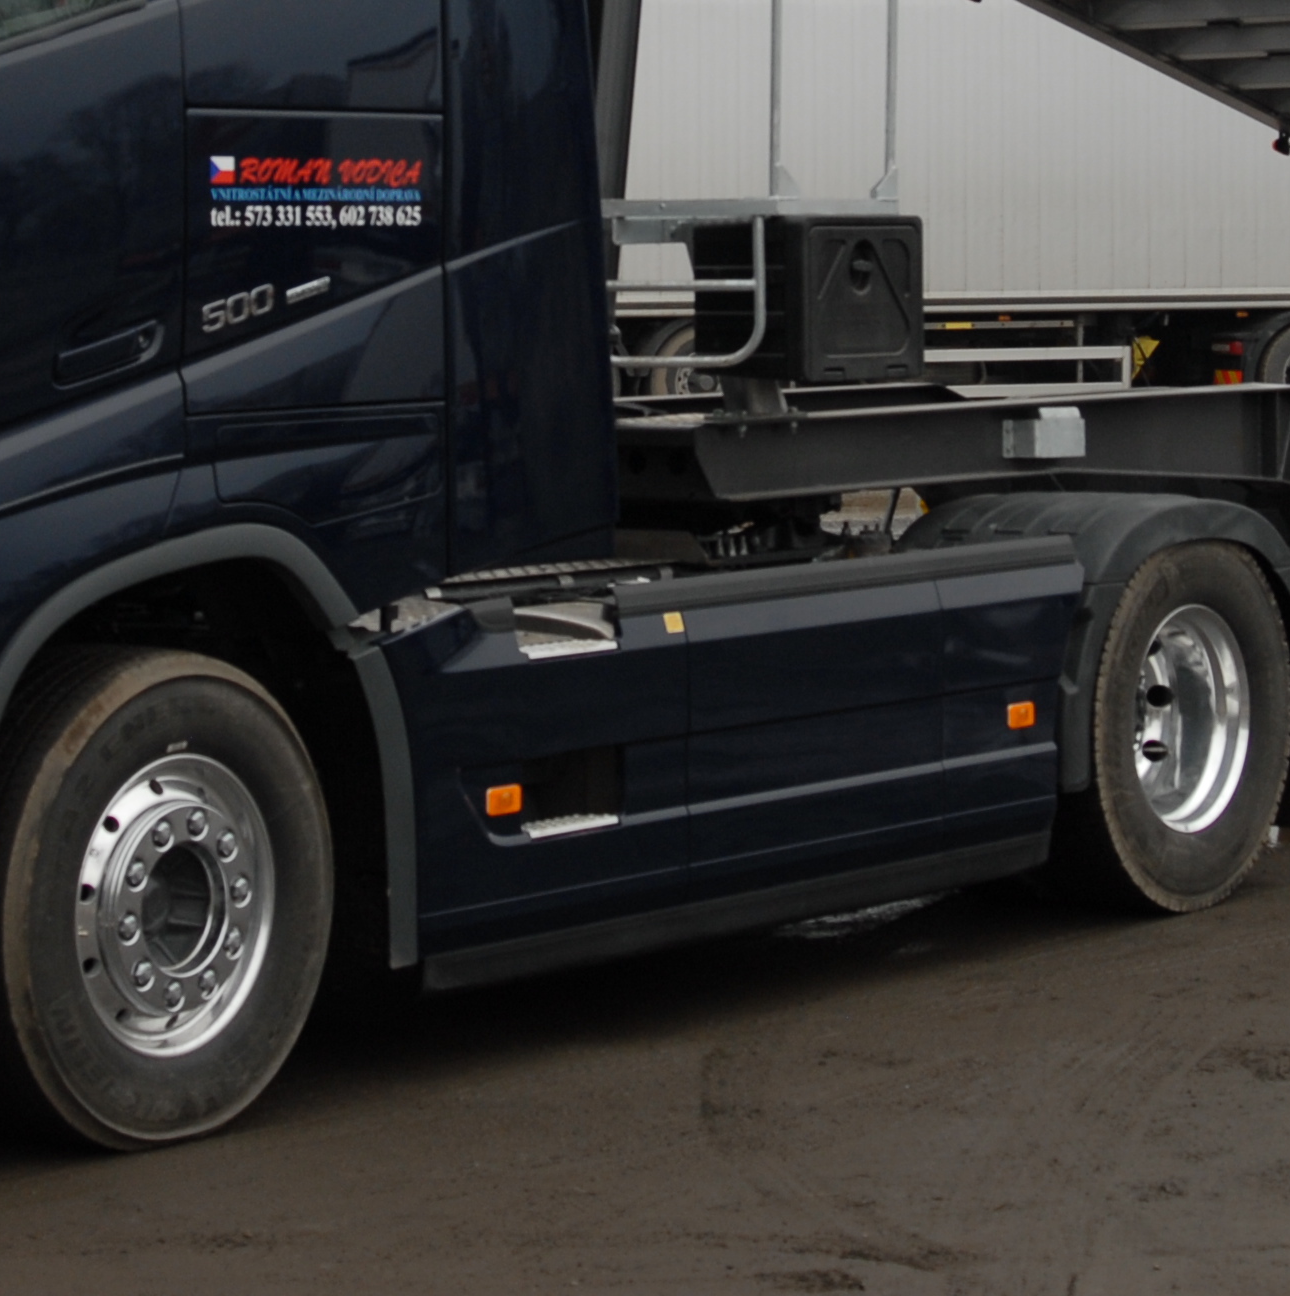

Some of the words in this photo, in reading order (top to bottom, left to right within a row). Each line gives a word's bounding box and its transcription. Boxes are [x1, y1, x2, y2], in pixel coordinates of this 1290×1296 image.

[239, 157, 332, 184] ROMAN
[338, 159, 422, 187] VODICA
[210, 205, 241, 227] tel.:
[244, 205, 273, 227] 573
[275, 205, 302, 227] 331
[305, 205, 338, 230] 553,
[339, 205, 365, 227] 602
[368, 205, 394, 227] 738
[395, 205, 422, 227] 625
[202, 283, 274, 333] 500
